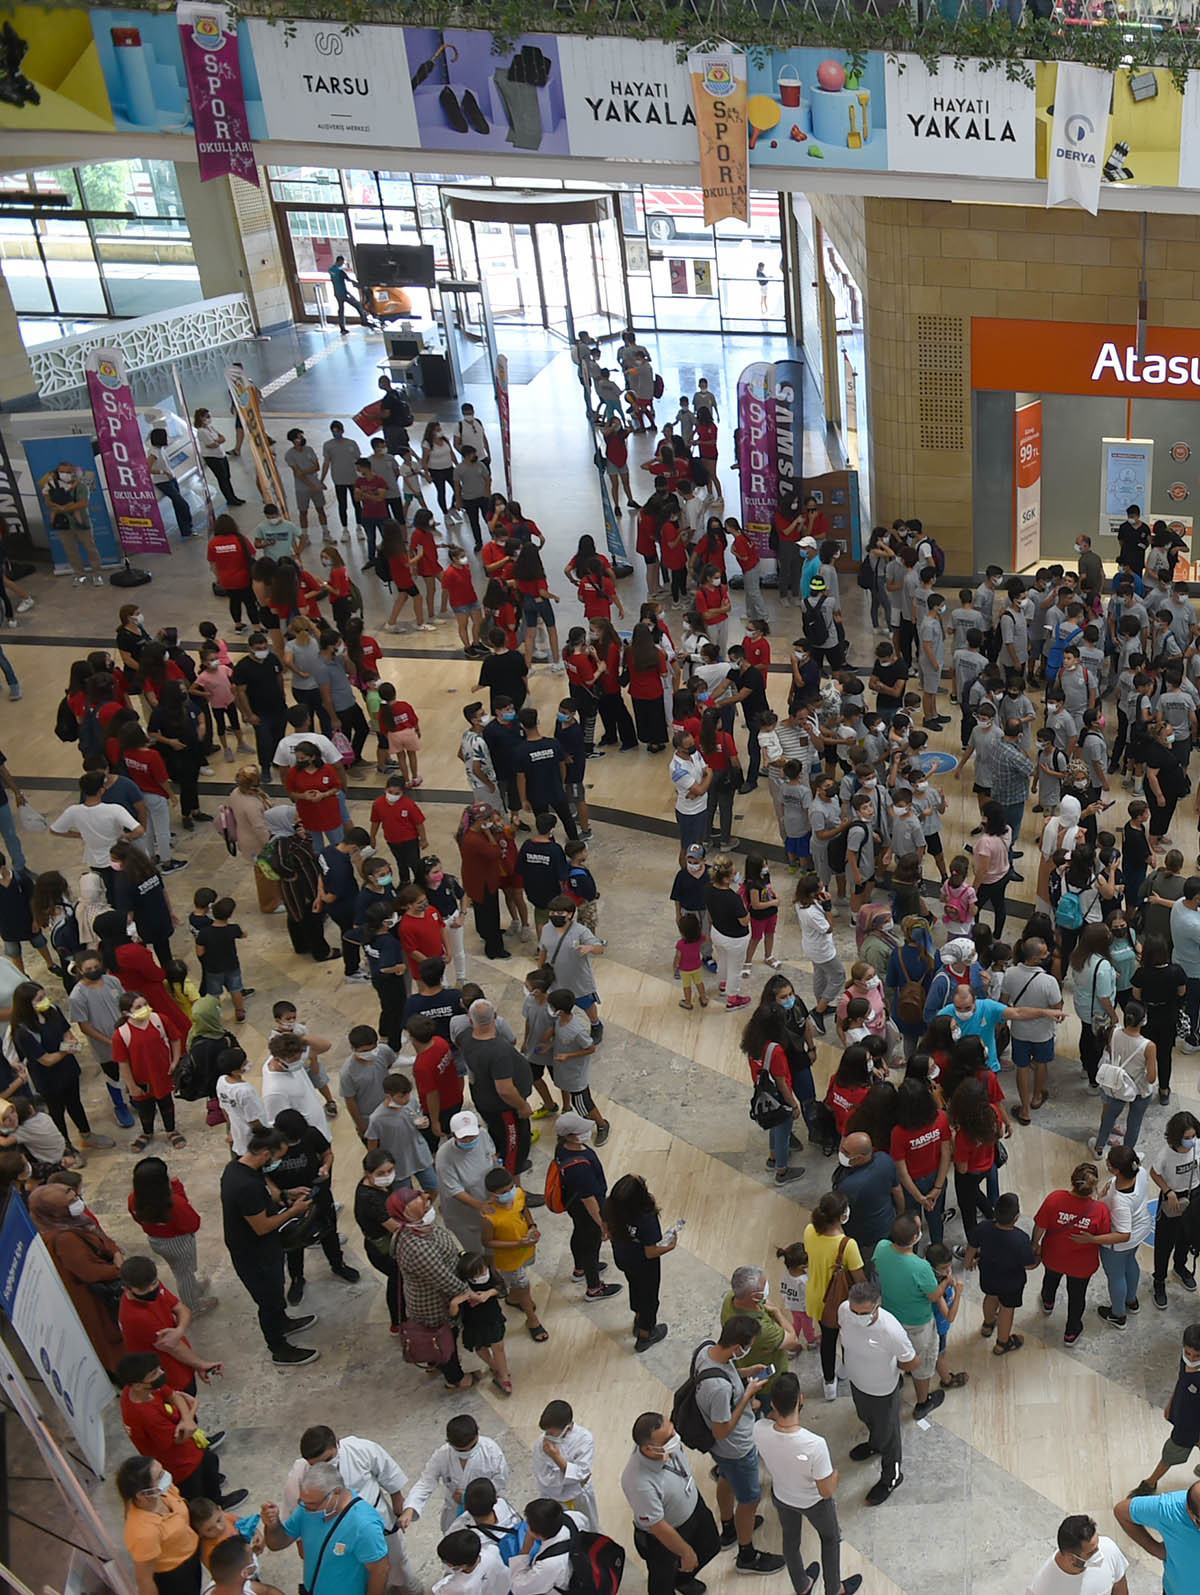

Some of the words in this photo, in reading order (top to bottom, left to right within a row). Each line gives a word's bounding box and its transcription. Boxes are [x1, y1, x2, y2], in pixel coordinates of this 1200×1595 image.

[303, 75, 369, 96] TARSU
[611, 81, 668, 98] HAYATI
[204, 54, 231, 139] SPOR
[933, 97, 989, 114] HAYATI
[585, 97, 697, 126] YAKALA
[907, 114, 1016, 142] YAKALA
[713, 101, 733, 184] SPOR
[1056, 148, 1096, 164] DERYA
[703, 185, 747, 198] OKULLA
[102, 391, 137, 488] SPOR
[749, 402, 767, 494] SPOR
[776, 381, 795, 498] SAMSU
[1020, 443, 1033, 464] 99
[1022, 507, 1037, 524] SGK
[910, 1128, 941, 1147] TARSUS
[1058, 1211, 1091, 1228] TARUS
